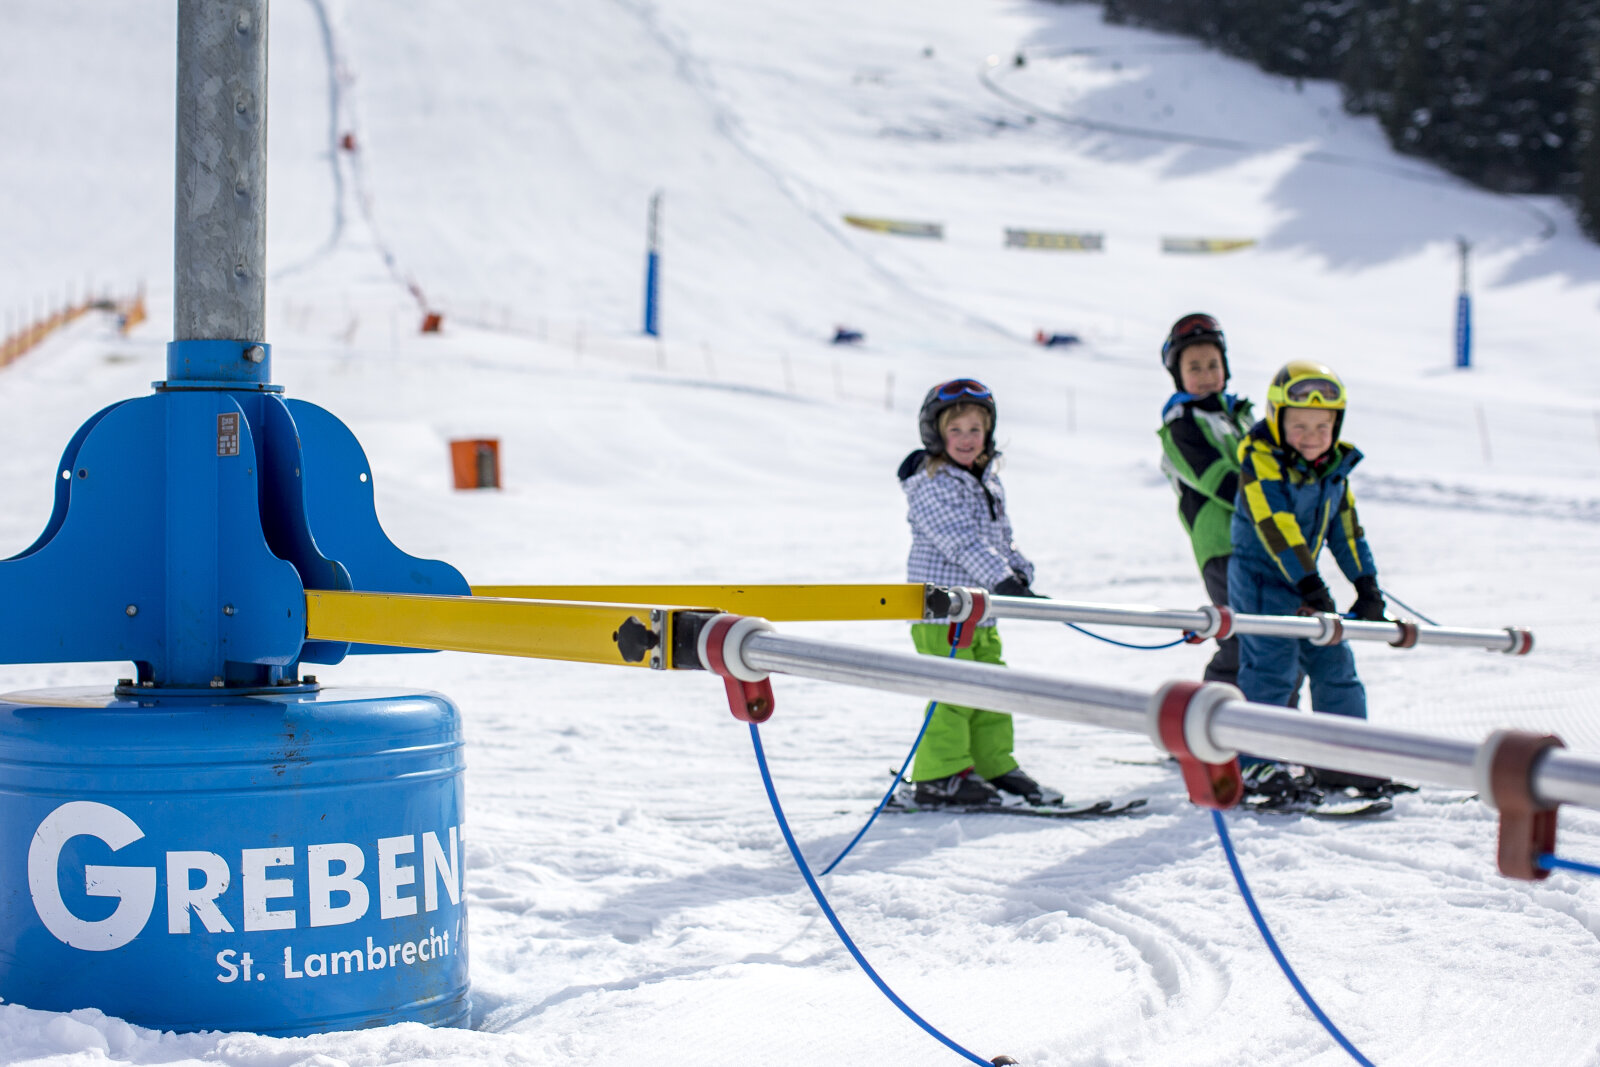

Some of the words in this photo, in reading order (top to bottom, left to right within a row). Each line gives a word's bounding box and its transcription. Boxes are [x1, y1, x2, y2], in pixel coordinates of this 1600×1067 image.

[27, 800, 465, 952] GREBEN
[216, 949, 266, 983] St.
[284, 926, 450, 979] Lambrecht
